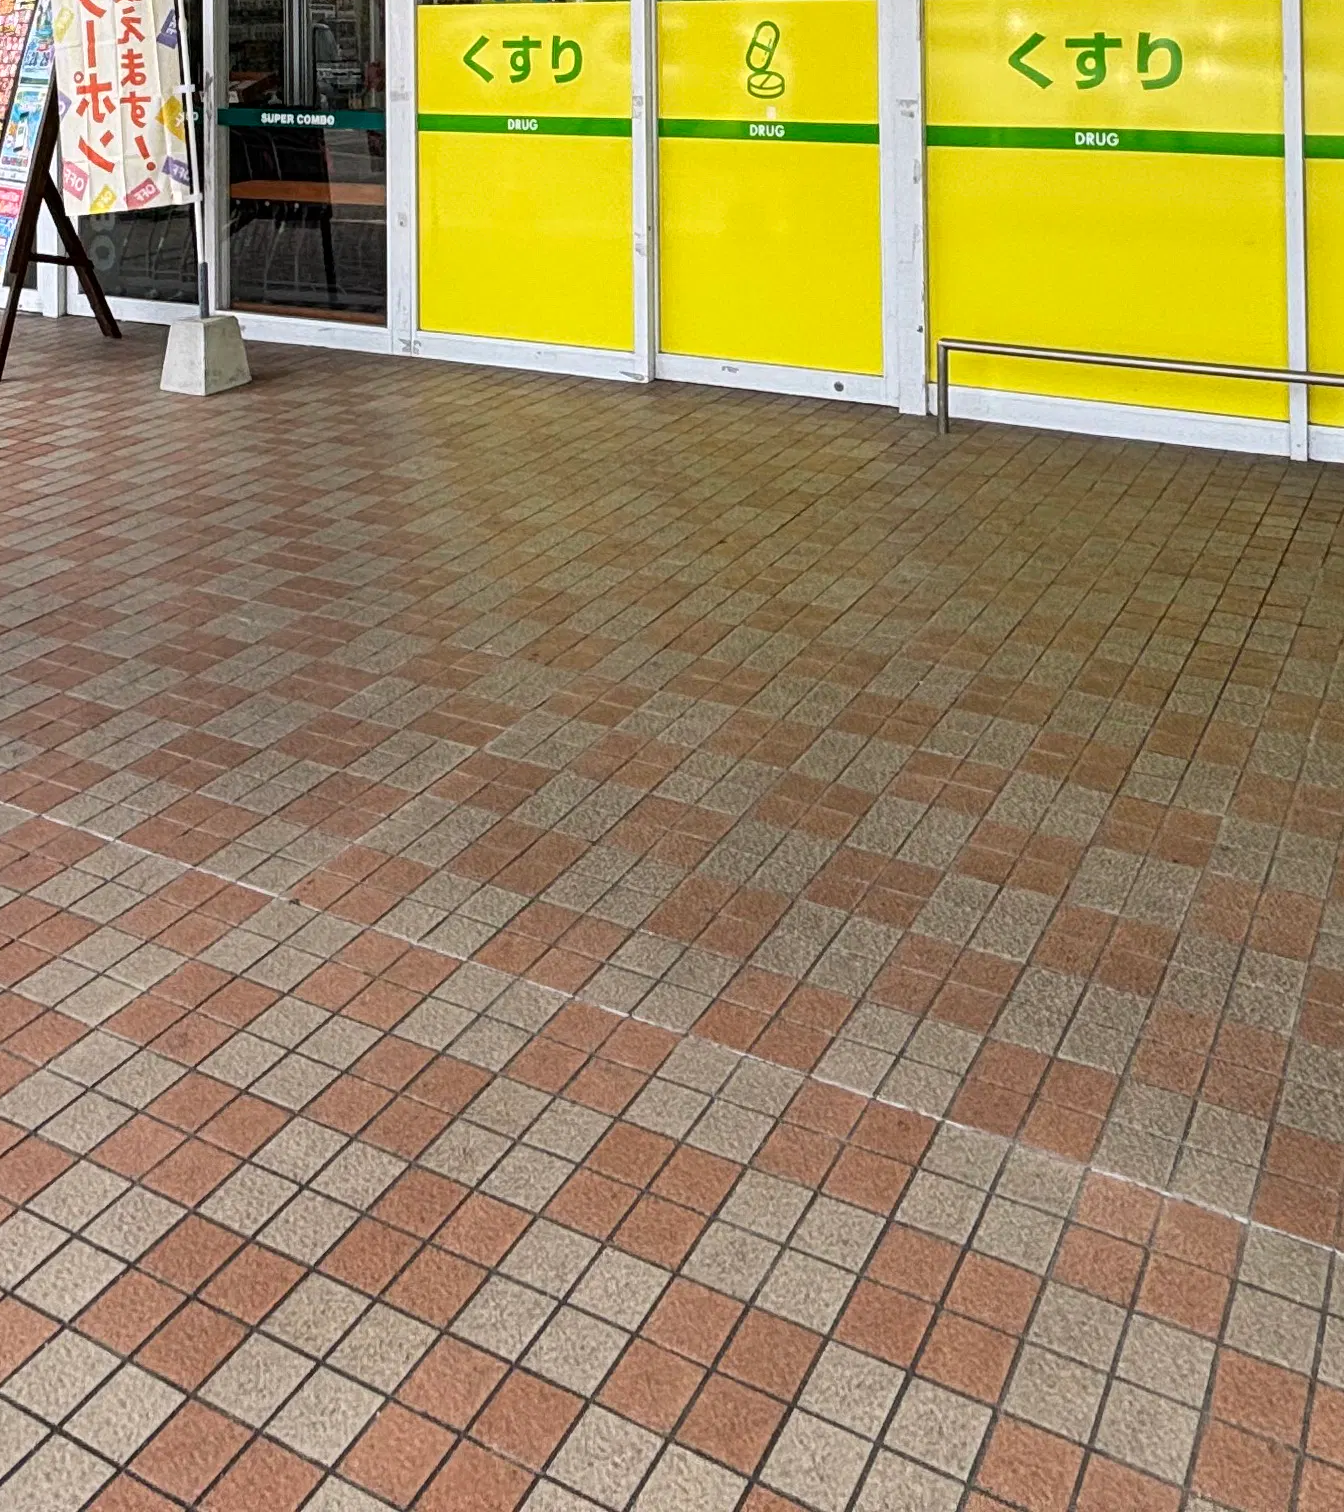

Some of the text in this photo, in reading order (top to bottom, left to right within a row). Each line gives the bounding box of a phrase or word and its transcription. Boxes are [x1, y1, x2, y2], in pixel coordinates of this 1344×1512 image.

[463, 35, 583, 84] くすり
[1008, 32, 1183, 90] くすり
[260, 112, 335, 126] SUPER COMBO
[507, 118, 538, 131] DRUG
[749, 124, 785, 138] DRUG
[1074, 132, 1119, 147] DRUG
